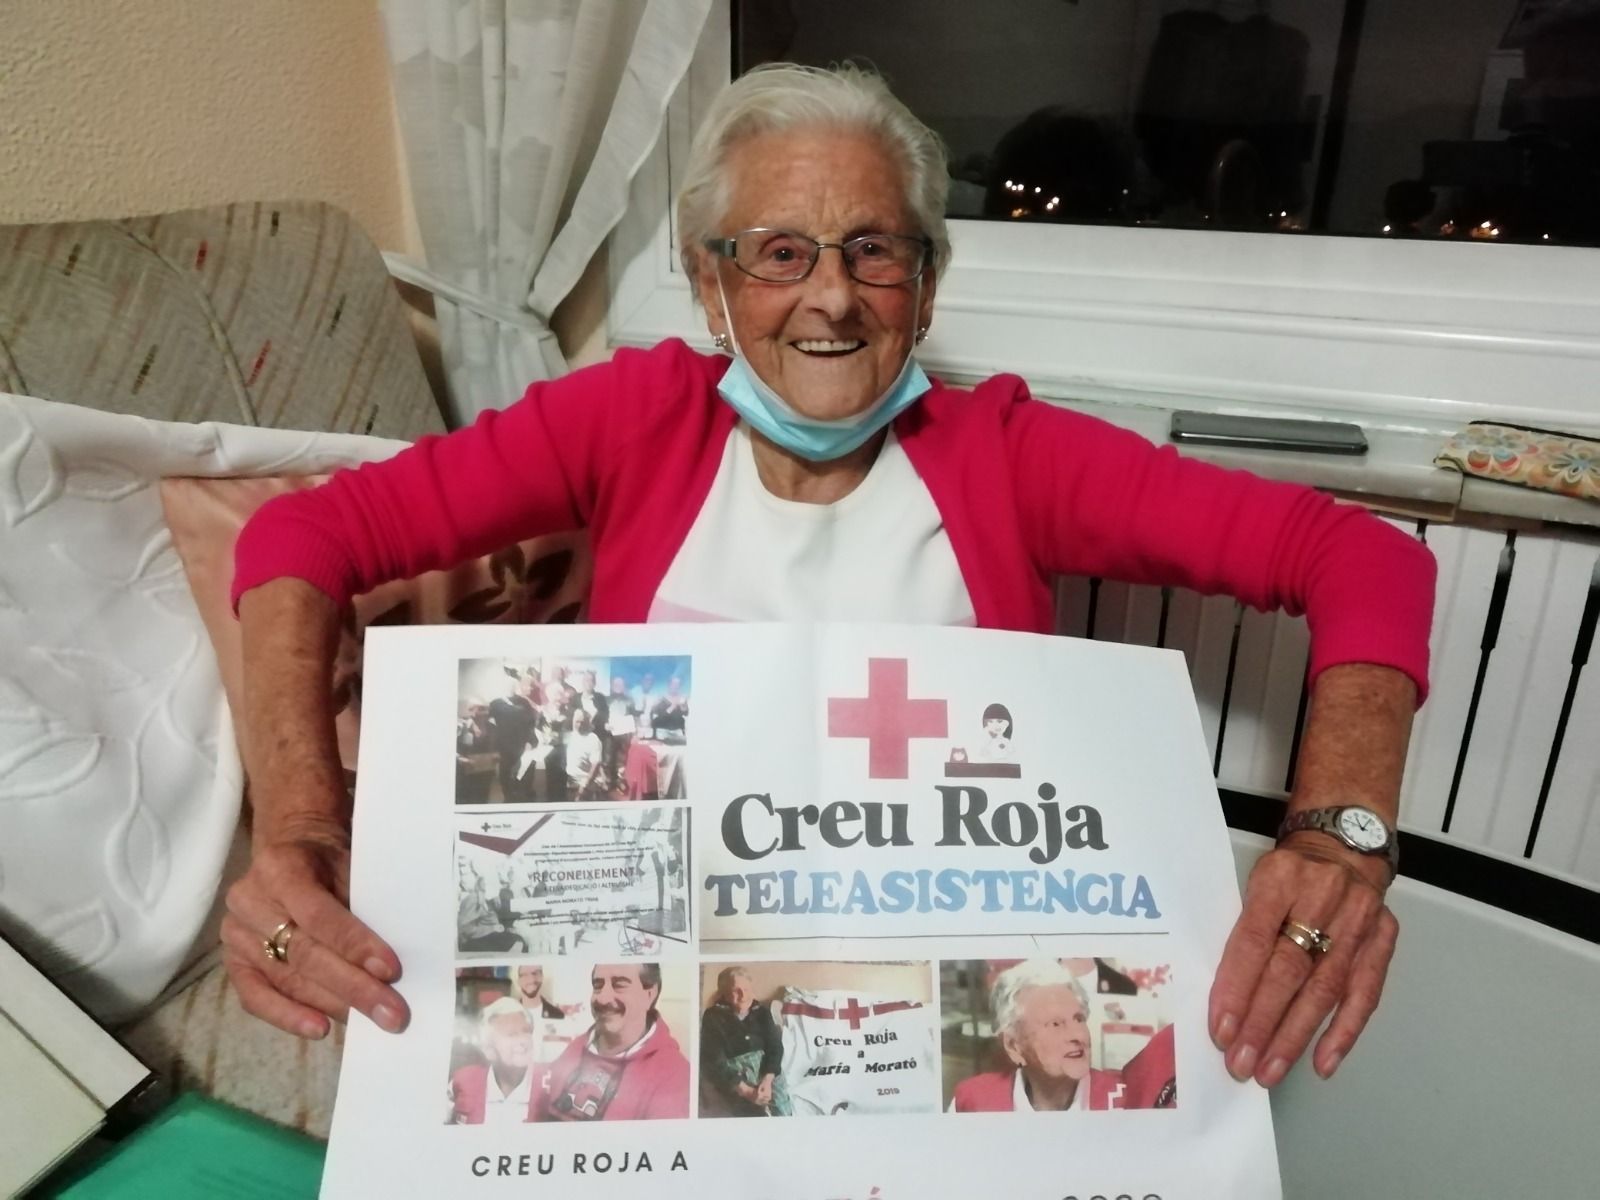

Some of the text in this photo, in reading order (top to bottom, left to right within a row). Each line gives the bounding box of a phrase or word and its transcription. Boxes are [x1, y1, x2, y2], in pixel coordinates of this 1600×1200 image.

[720, 782, 1109, 865] Creu Roja
[533, 867, 635, 882] RECONEIXEMENT
[704, 867, 1162, 920] TELEASISTENCIA
[814, 1028, 898, 1047] Creu Roja
[857, 1050, 865, 1058] a
[803, 1057, 918, 1077] María Morató
[471, 1150, 689, 1177] CREU ROJA A
